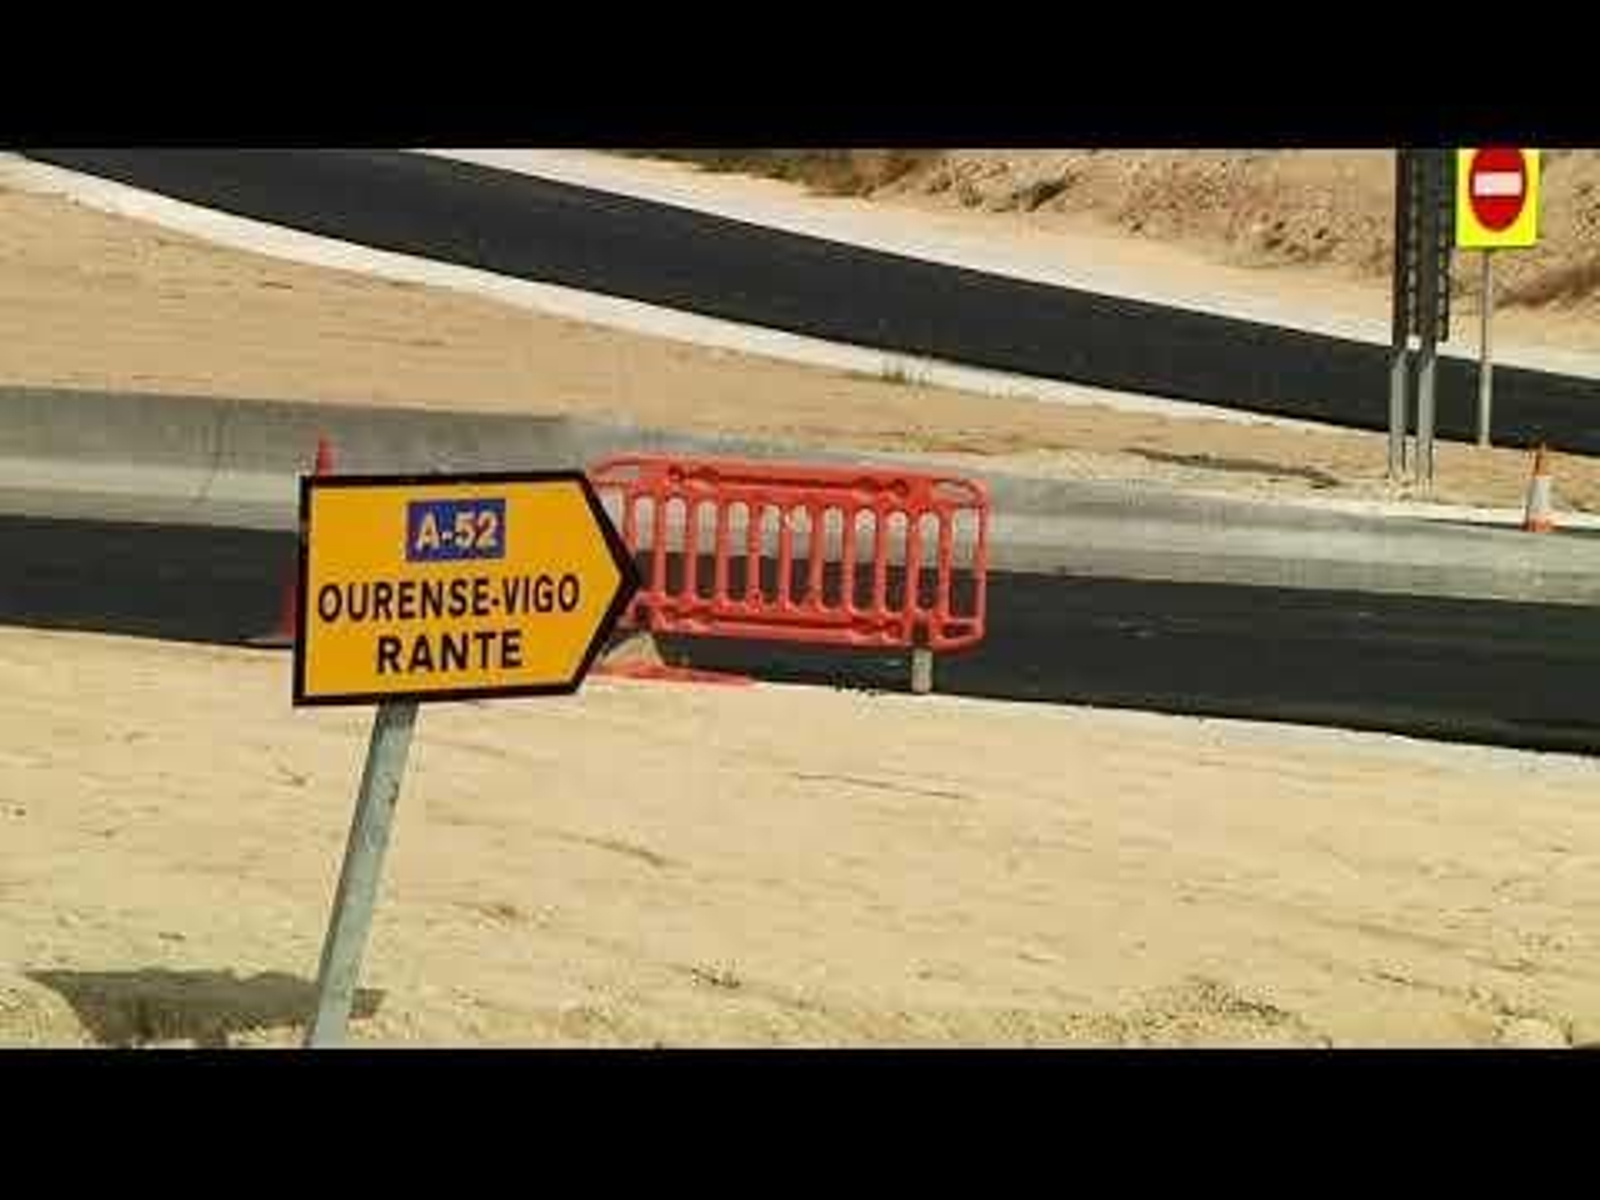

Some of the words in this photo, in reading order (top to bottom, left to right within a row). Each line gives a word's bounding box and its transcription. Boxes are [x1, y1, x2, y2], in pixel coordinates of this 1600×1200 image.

[416, 511, 499, 551] A-52
[318, 574, 580, 623] OURENSE-VIGO
[376, 630, 523, 674] RANTE
